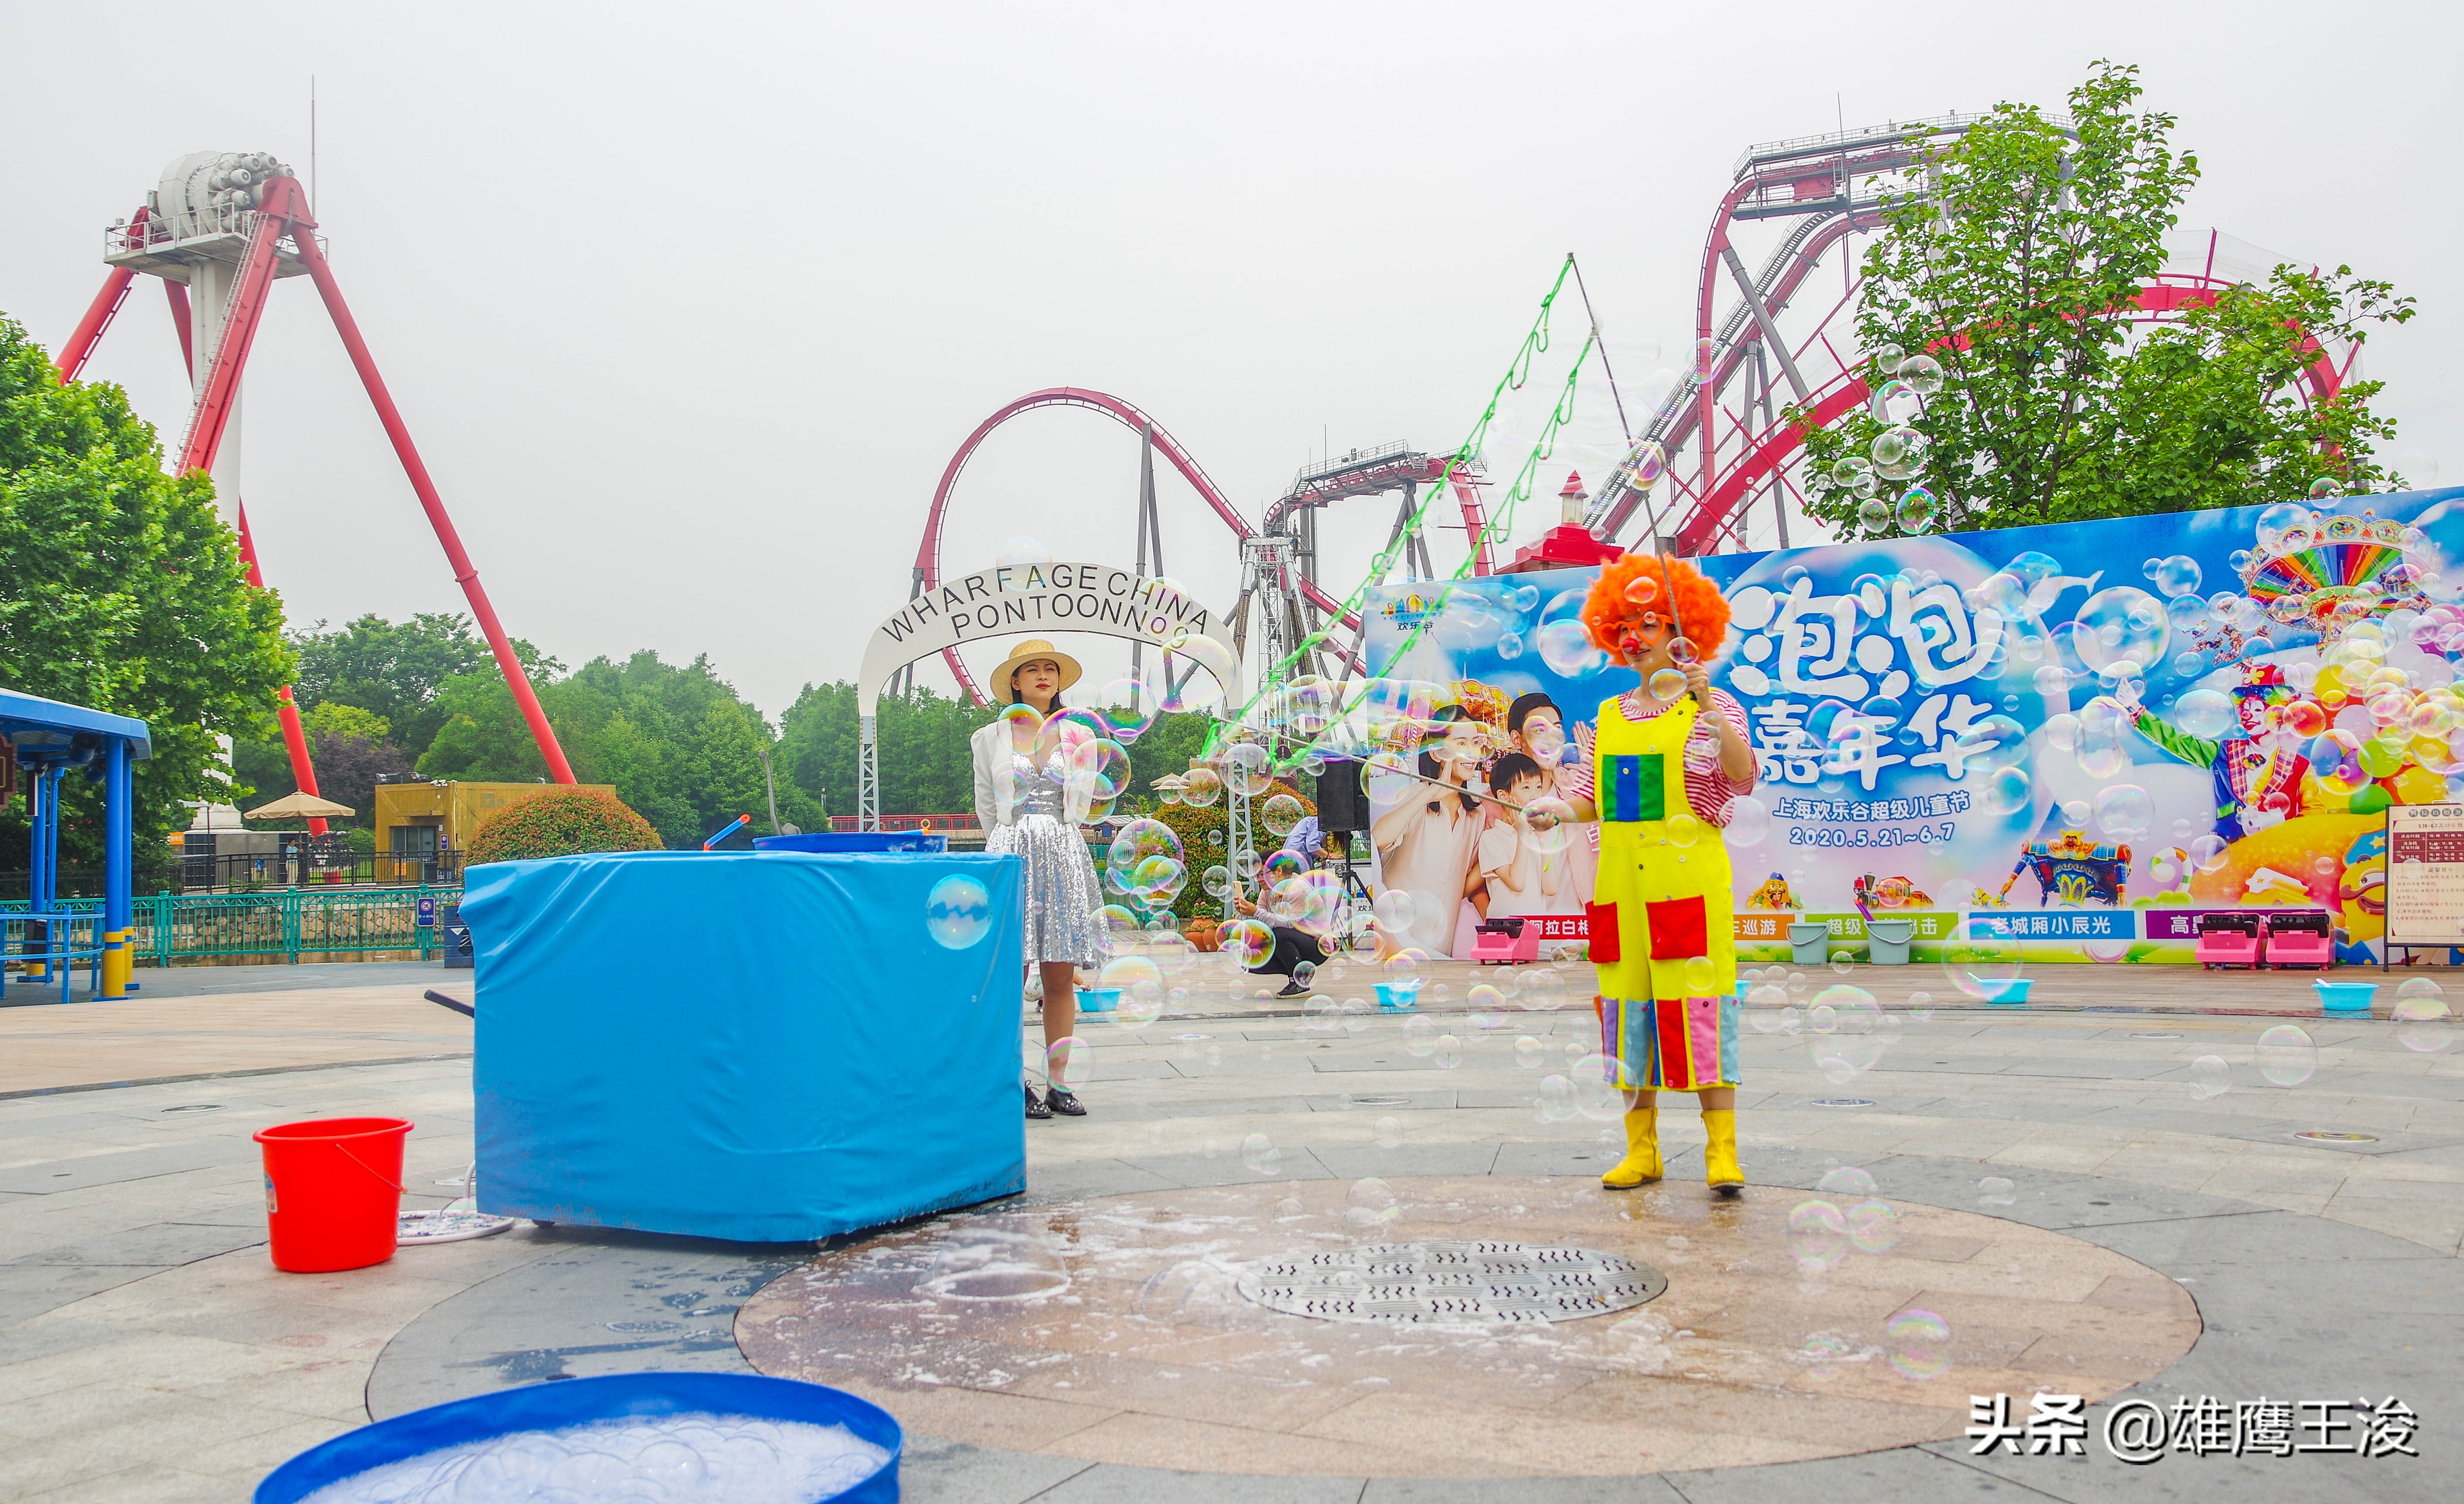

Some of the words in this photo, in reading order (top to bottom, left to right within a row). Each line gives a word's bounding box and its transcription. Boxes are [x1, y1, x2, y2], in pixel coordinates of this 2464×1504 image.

[1107, 572, 1208, 635] CHINA
[1729, 576, 2004, 701] 泡泡
[1751, 694, 2000, 791] 嘉年华
[1773, 790, 1970, 822] 上海欢乐谷超级儿童节
[1789, 822, 1955, 847] 2020.5.21~6.7
[1991, 916, 2111, 935] 老城厢小辰光
